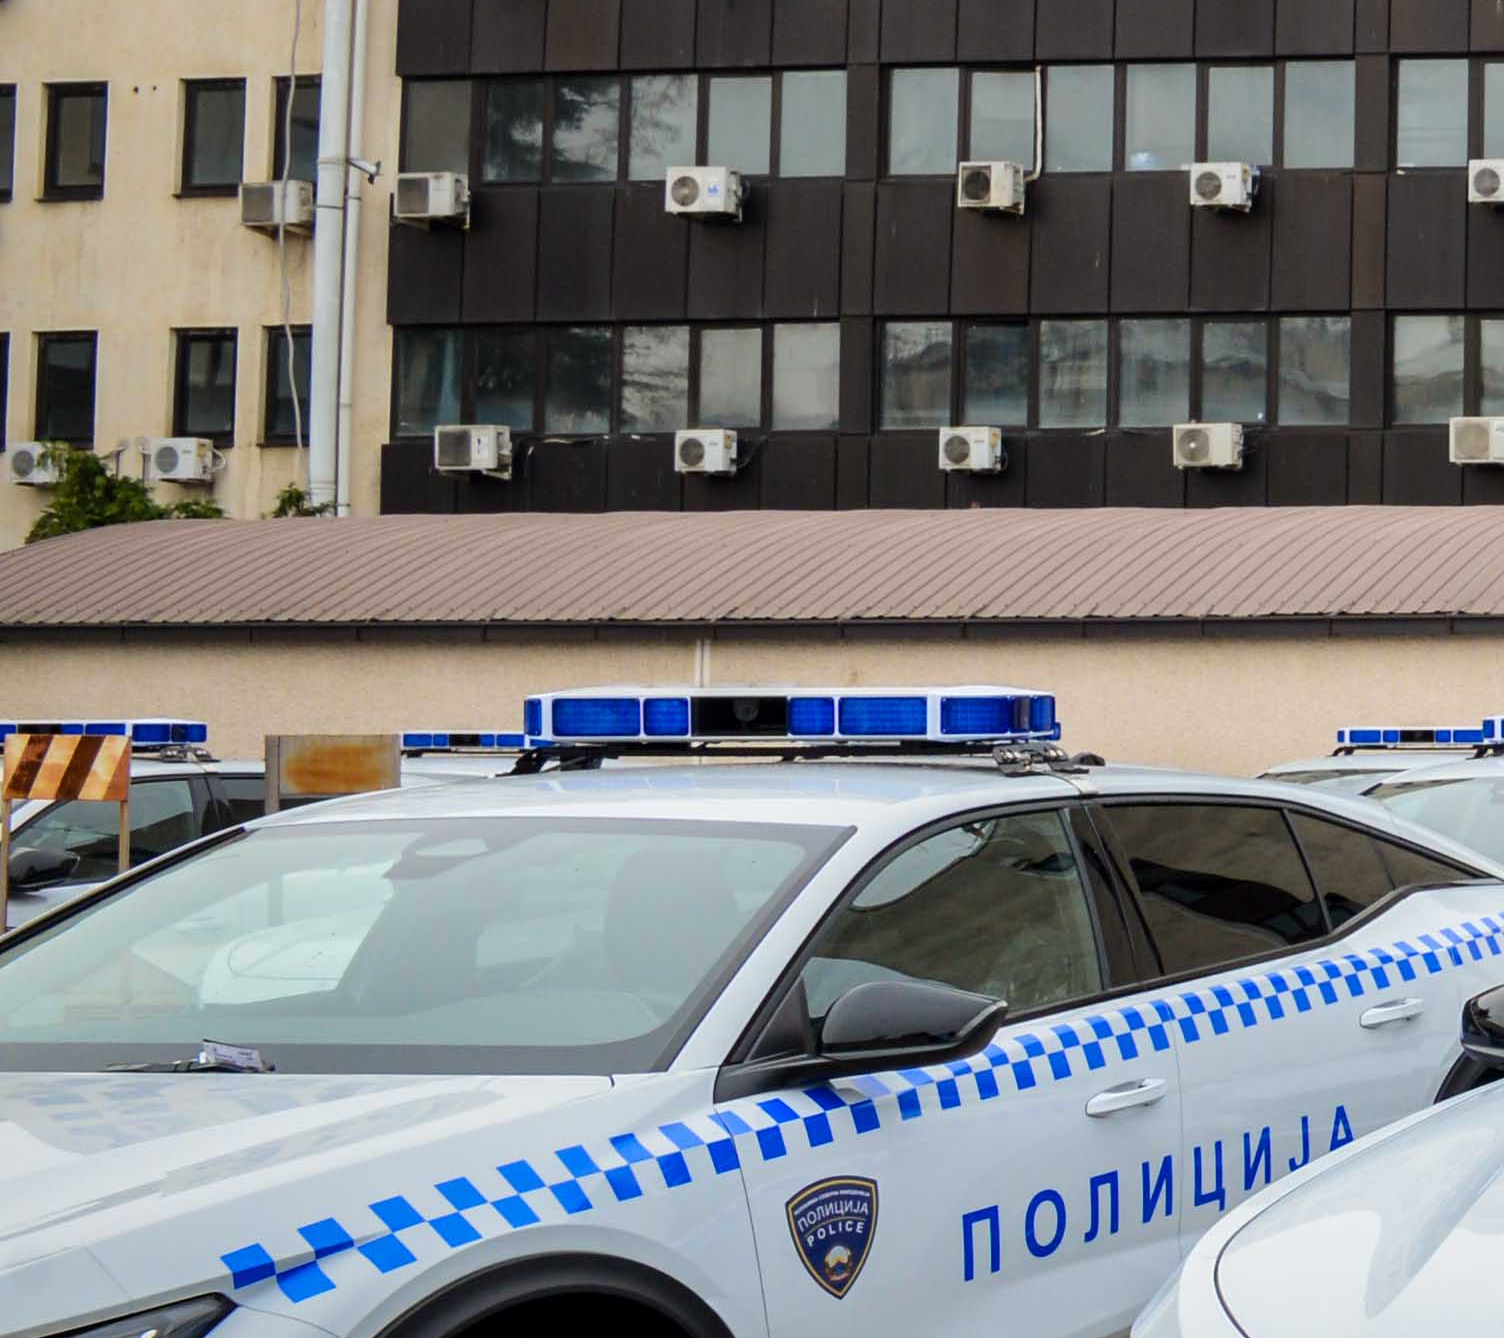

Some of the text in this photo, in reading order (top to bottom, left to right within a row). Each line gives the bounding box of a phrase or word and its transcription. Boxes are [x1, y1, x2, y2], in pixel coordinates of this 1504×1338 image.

[961, 1105, 1355, 1282] ПОЛИЦИЈА
[797, 1200, 868, 1233] ПОЛИЦИЈА
[806, 1220, 865, 1247] POLICE
